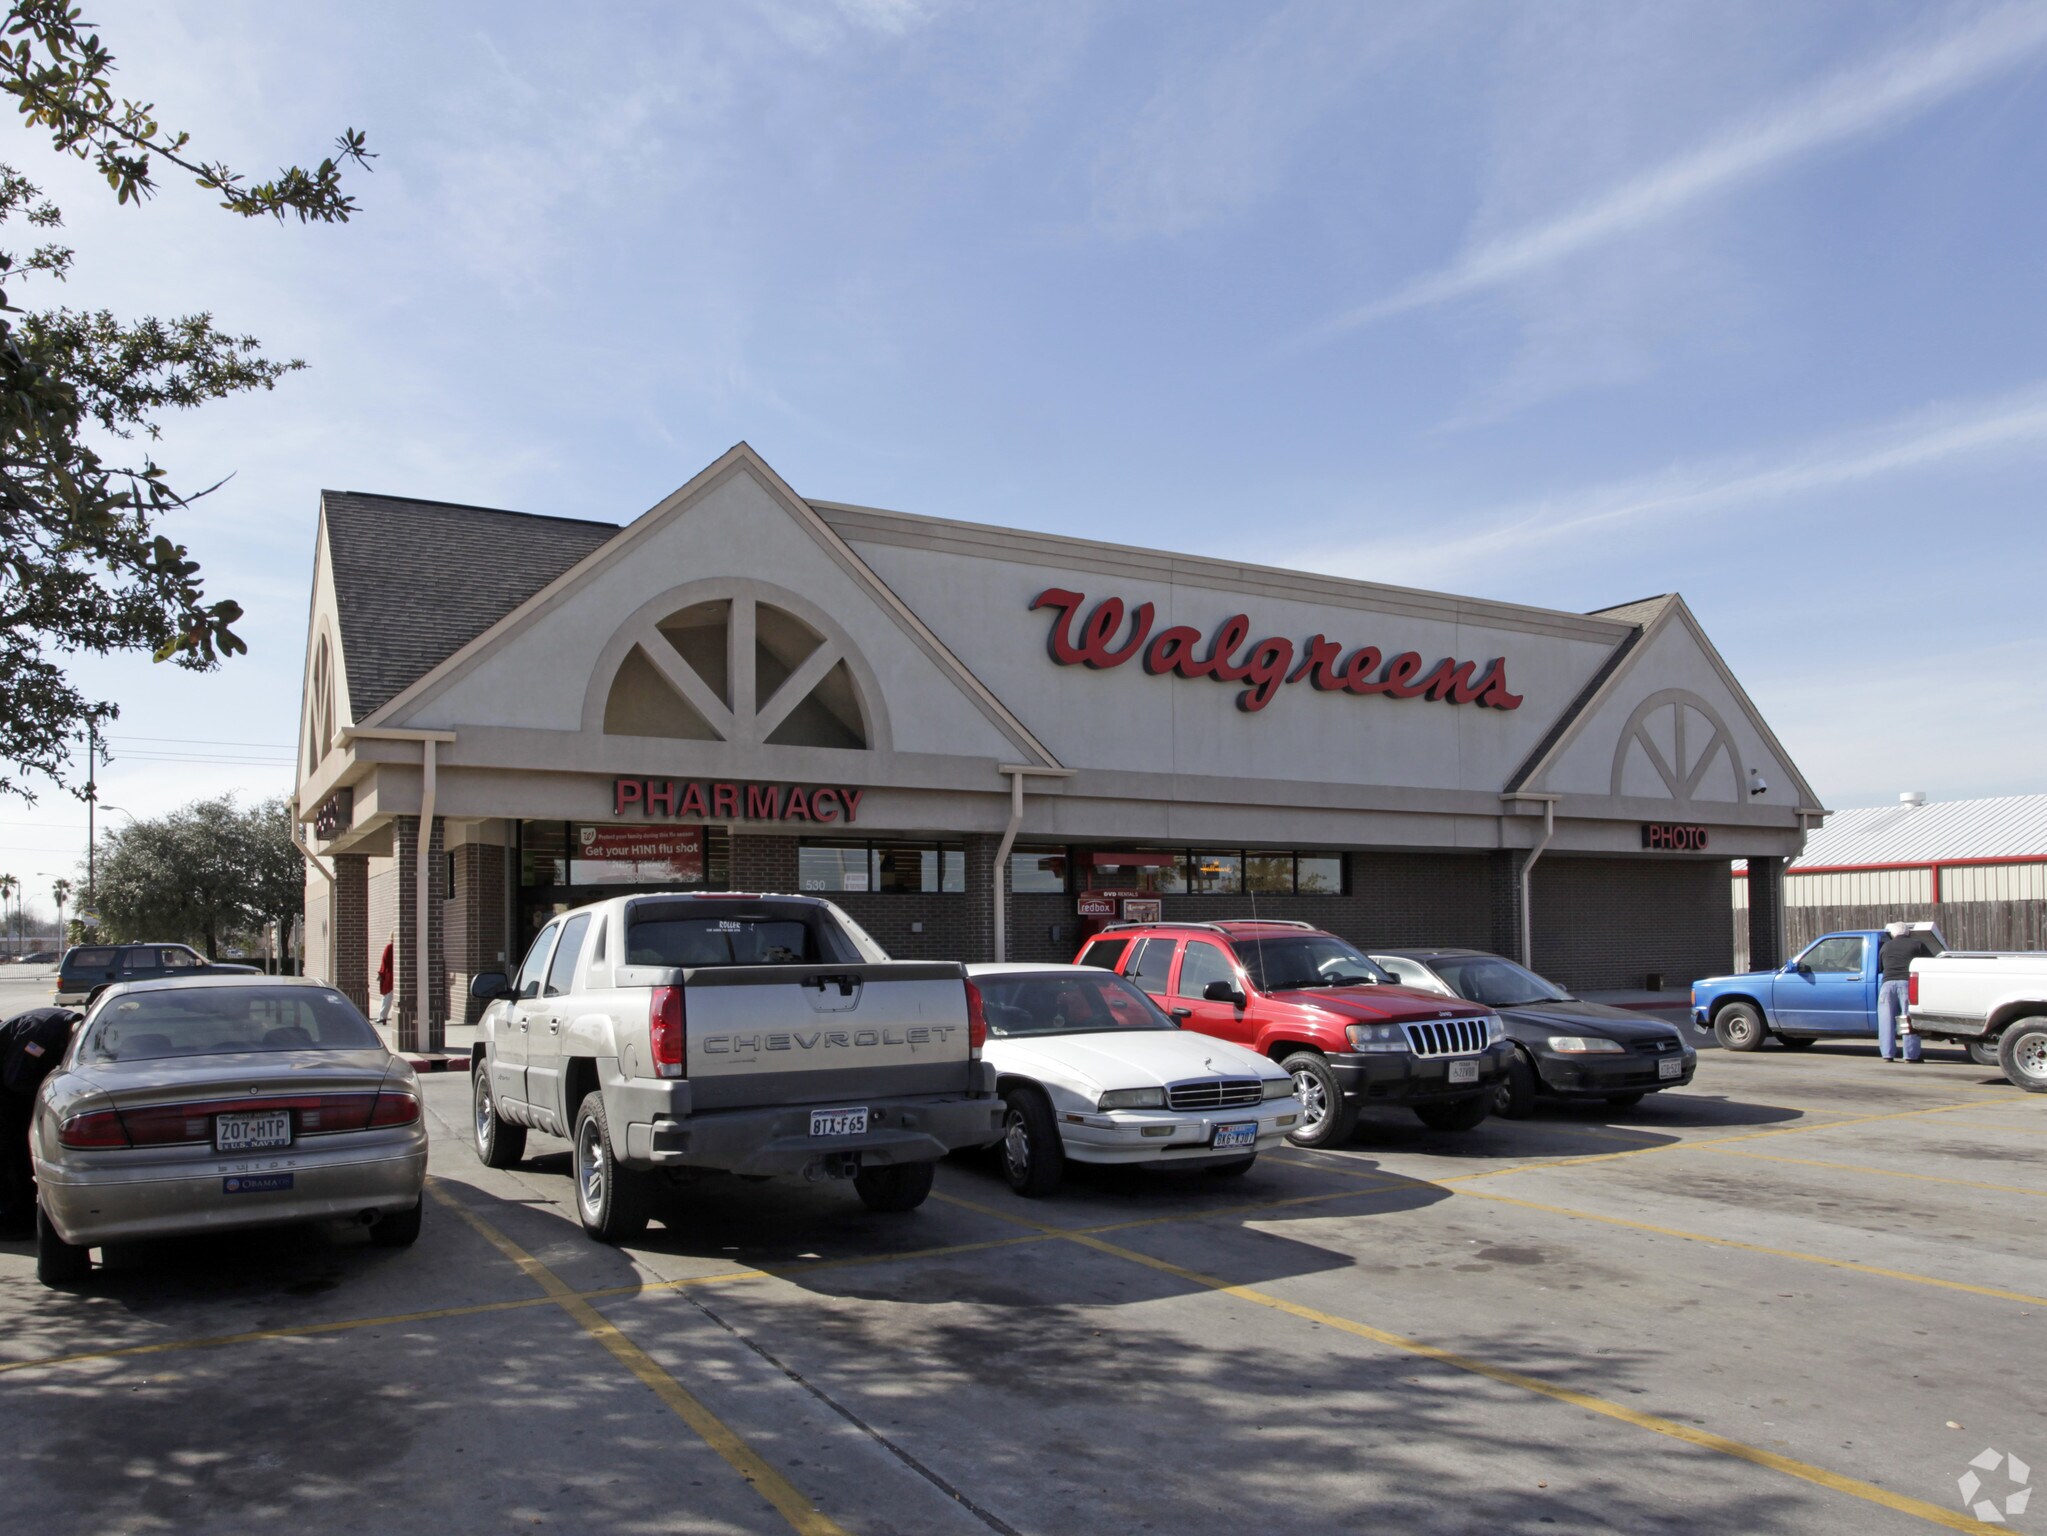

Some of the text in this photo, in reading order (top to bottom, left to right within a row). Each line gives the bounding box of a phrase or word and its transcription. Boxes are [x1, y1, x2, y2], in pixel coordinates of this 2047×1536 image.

[1029, 588, 1524, 712] Walgreens
[614, 779, 864, 823] PHARMACY
[1648, 824, 1709, 849] PHOTO
[585, 842, 698, 857] Get your H1N1 flu shot
[805, 880, 826, 891] 530
[1081, 902, 1110, 912] redbox
[703, 1026, 956, 1054] CHEVROLET
[251, 1139, 276, 1147] NAVY
[242, 1179, 278, 1189] OBAMA
